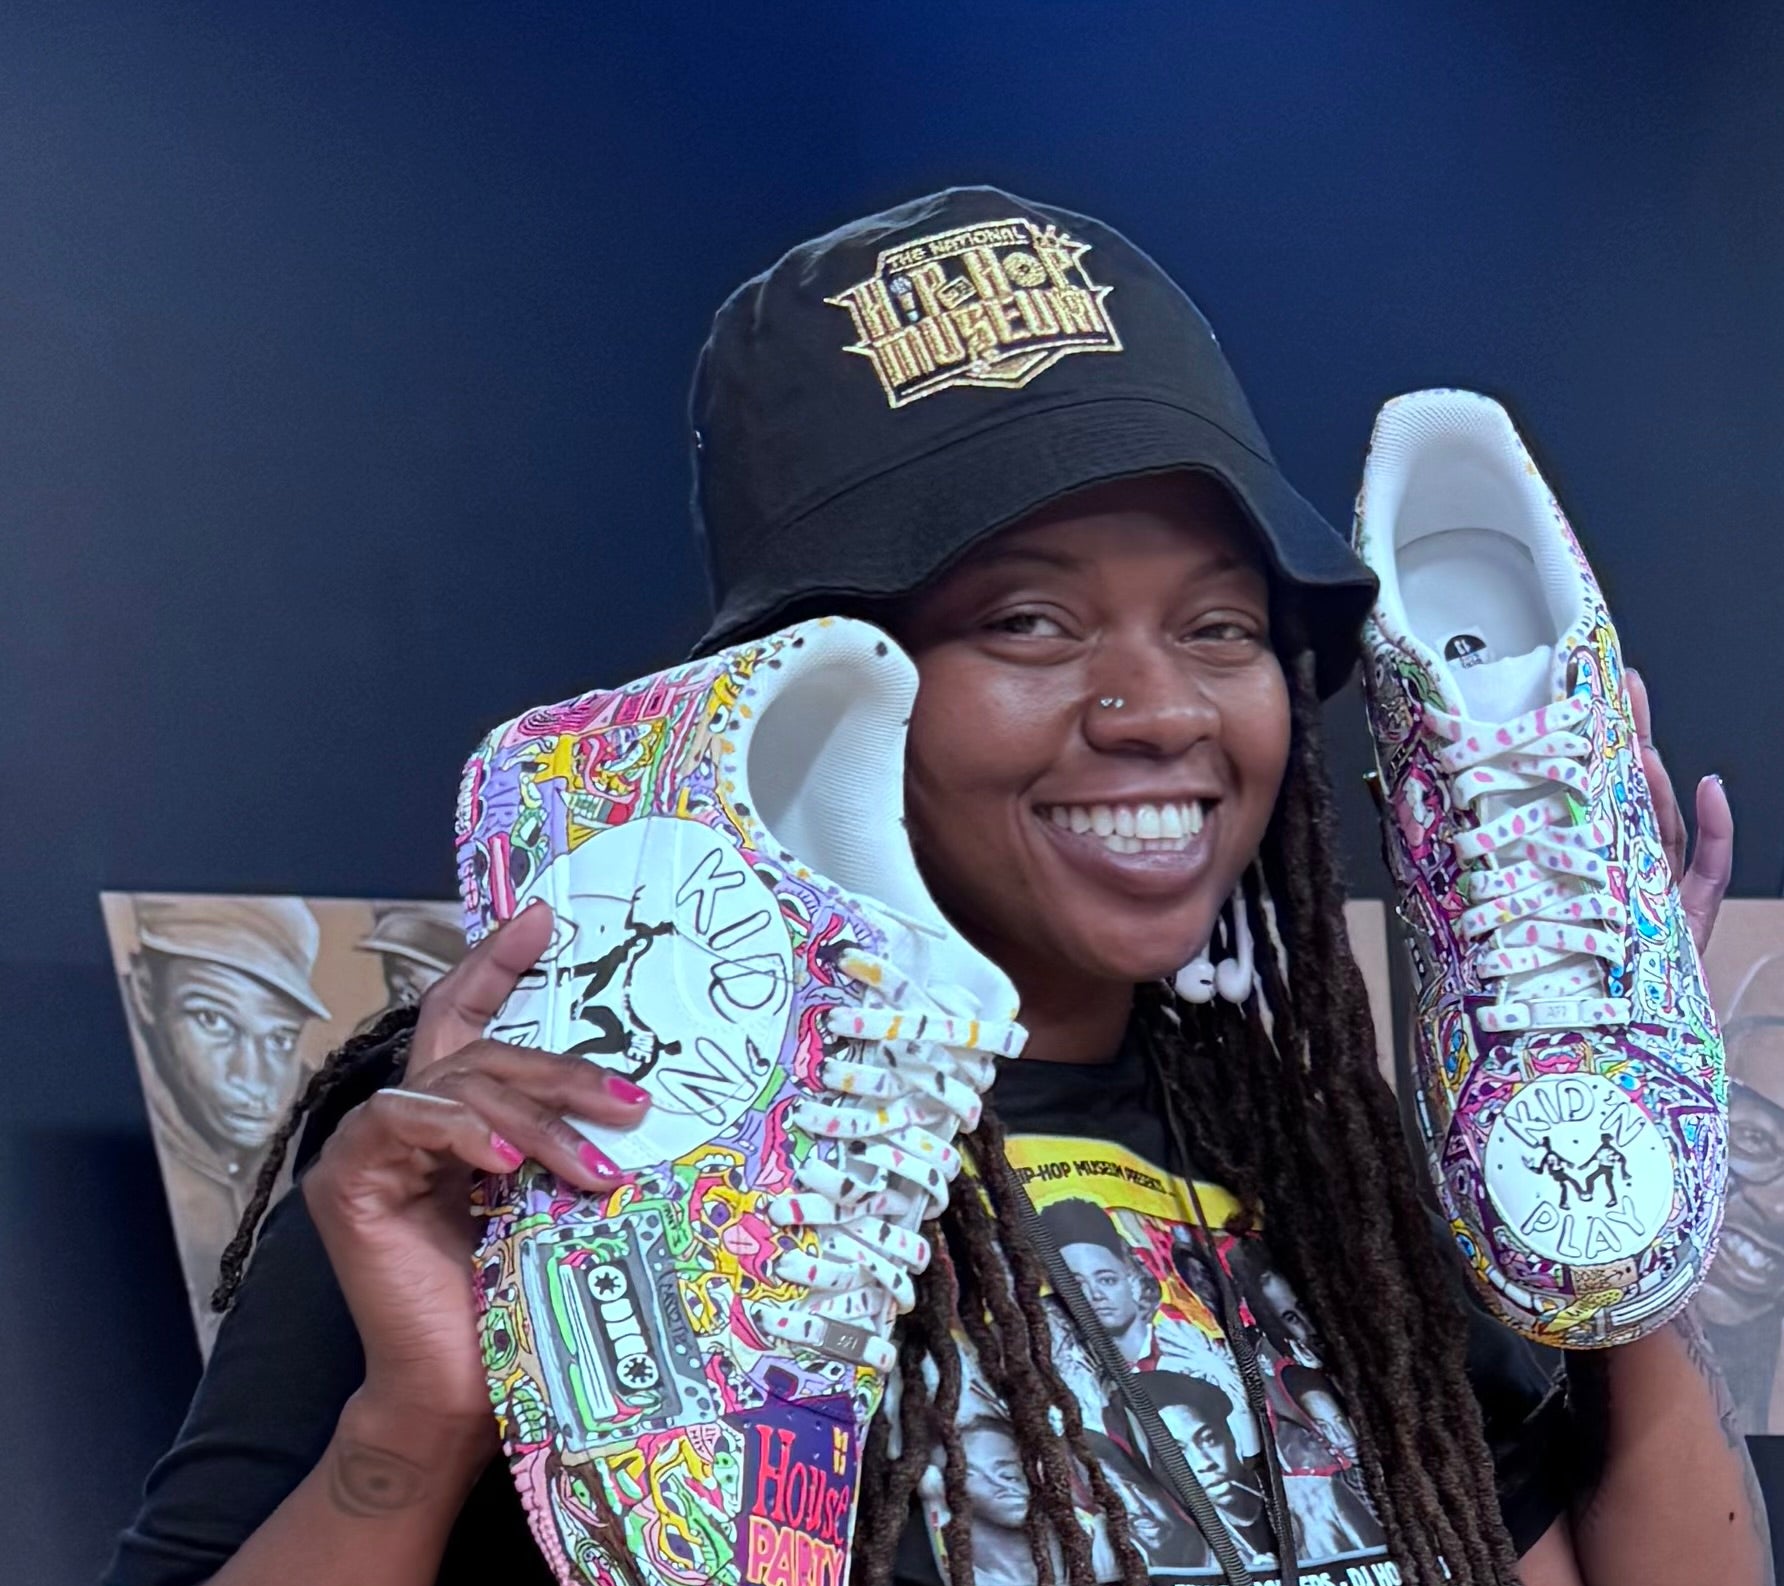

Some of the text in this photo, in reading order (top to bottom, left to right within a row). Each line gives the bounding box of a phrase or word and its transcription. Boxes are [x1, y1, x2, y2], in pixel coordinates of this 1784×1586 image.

[928, 224, 1027, 257] NATIONAL
[878, 287, 1104, 387] MUSEUM
[1504, 1078, 1597, 1148] KID
[1521, 1195, 1646, 1261] PLAY
